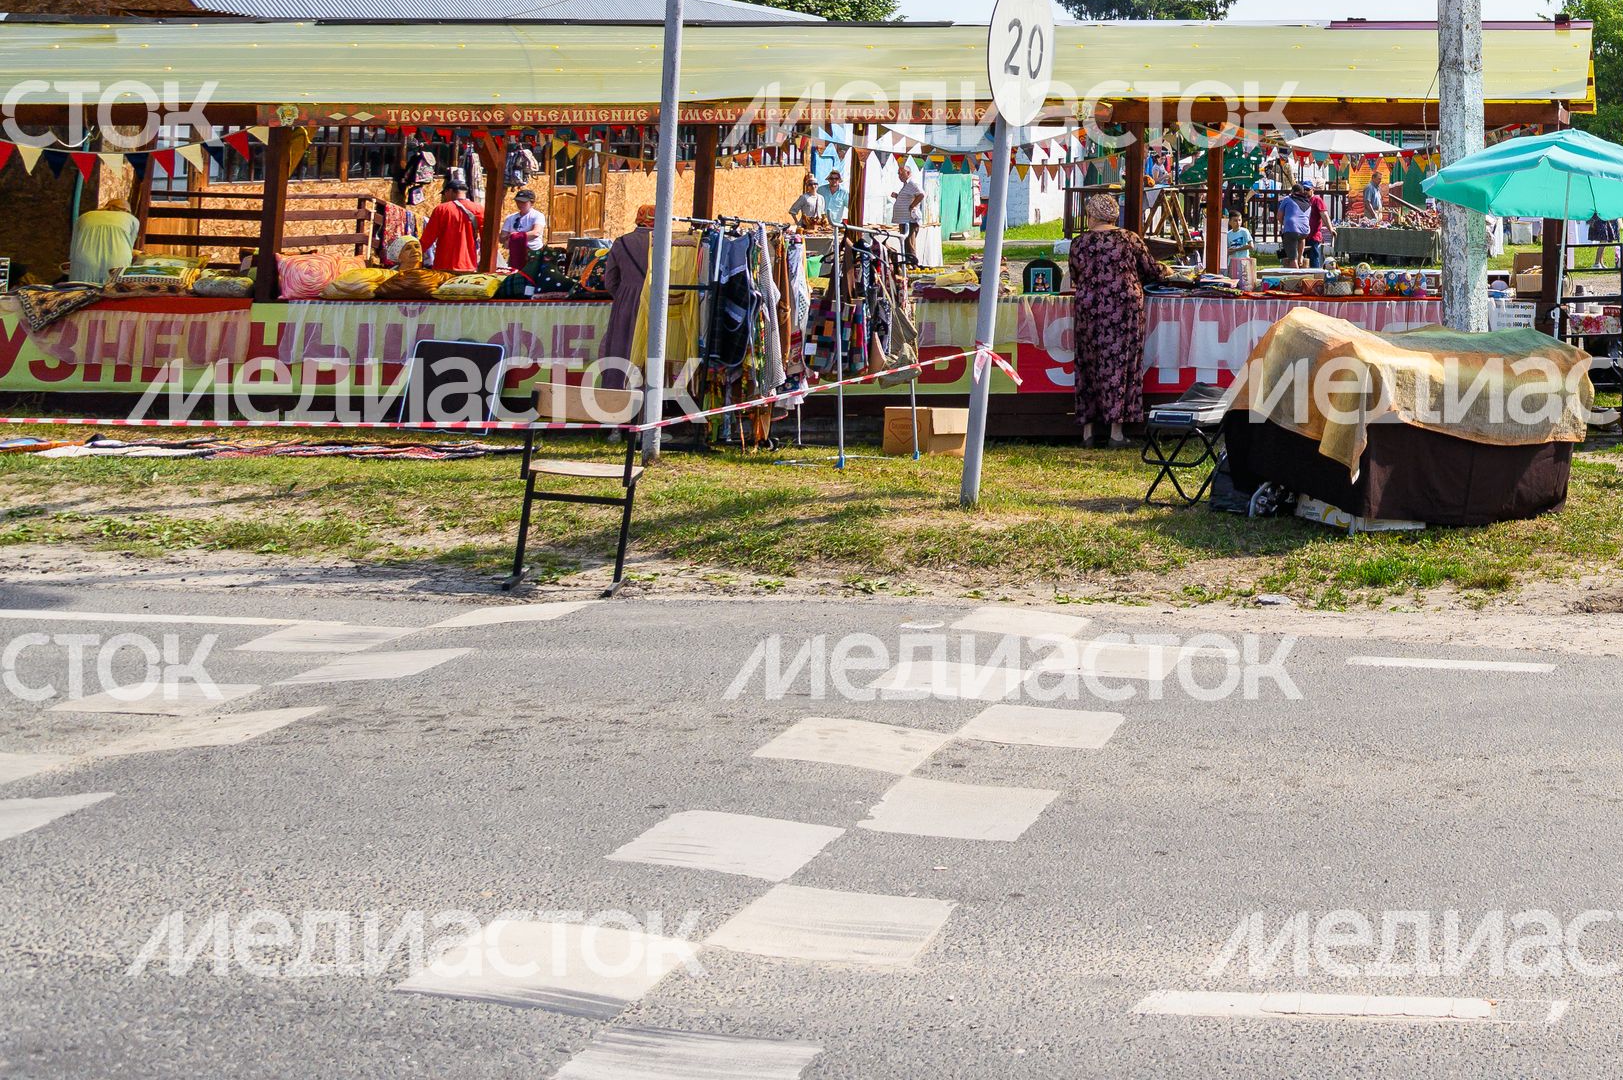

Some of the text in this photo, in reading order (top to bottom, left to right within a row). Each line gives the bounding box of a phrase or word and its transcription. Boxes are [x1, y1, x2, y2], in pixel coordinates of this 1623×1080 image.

[1004, 18, 1043, 80] 20
[387, 108, 505, 122] ТВОРЧЕСКОЕ
[512, 108, 649, 123] ОБЪЕДИНЕНИЕ
[753, 108, 790, 120] ПРИ
[798, 107, 914, 121] НИКИТСКОМ
[921, 106, 987, 120] ХРАМЕ
